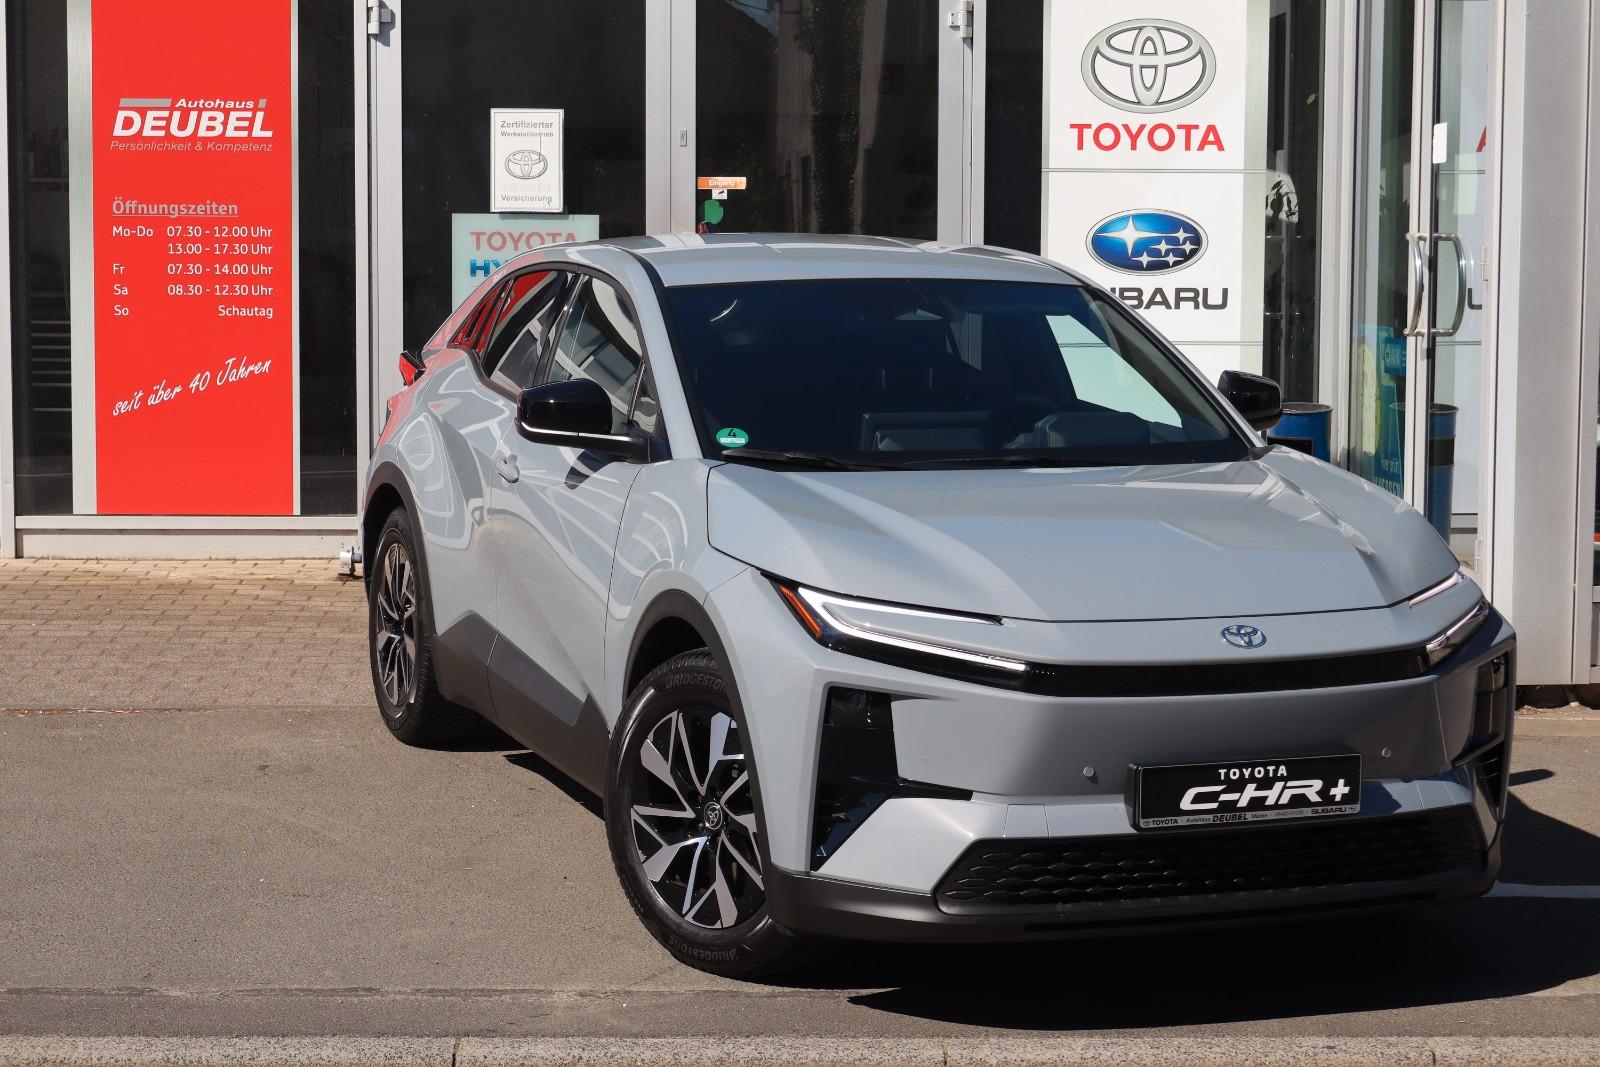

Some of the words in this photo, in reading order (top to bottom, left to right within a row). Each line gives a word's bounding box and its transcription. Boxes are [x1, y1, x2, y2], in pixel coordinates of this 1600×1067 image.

[175, 98, 254, 108] Autohaus
[112, 110, 273, 137] DEUBEL
[500, 120, 554, 129] Zertifizierter
[1069, 123, 1225, 151] TOYOTA
[110, 140, 191, 151] Persönlichkeit
[195, 141, 203, 151] &
[207, 141, 273, 153] Kompetenz
[501, 193, 553, 204] Versicherung
[112, 197, 238, 218] Öffnungszeiten
[112, 226, 154, 237] Mo-Do
[167, 226, 202, 237] 07.30
[214, 226, 248, 237] 12.00
[250, 226, 273, 237] Uhr
[167, 244, 202, 254] 13.00
[214, 244, 248, 254] 17.30
[250, 244, 273, 254] Uhr
[113, 264, 125, 274] Fr
[167, 264, 202, 274] 07.30
[214, 264, 248, 274] 14.00
[250, 264, 273, 274] Uhr
[113, 284, 128, 296] Sa
[167, 284, 202, 296] 08.30
[214, 284, 248, 296] 12.30
[250, 284, 273, 296] Uhr
[1109, 287, 1229, 310] BARU
[114, 305, 129, 316] So
[218, 305, 273, 318] Schautag
[112, 389, 144, 416] seit
[147, 379, 183, 406] über
[189, 371, 211, 394] 40
[216, 355, 272, 386] Jahren
[728, 428, 736, 438] 4
[665, 673, 729, 693] BRIDGESTON
[1218, 765, 1288, 781] TOYOTA
[1151, 818, 1178, 826] TOYOTA
[1212, 813, 1249, 823] DEUBEL
[1310, 806, 1347, 815] SUBARU
